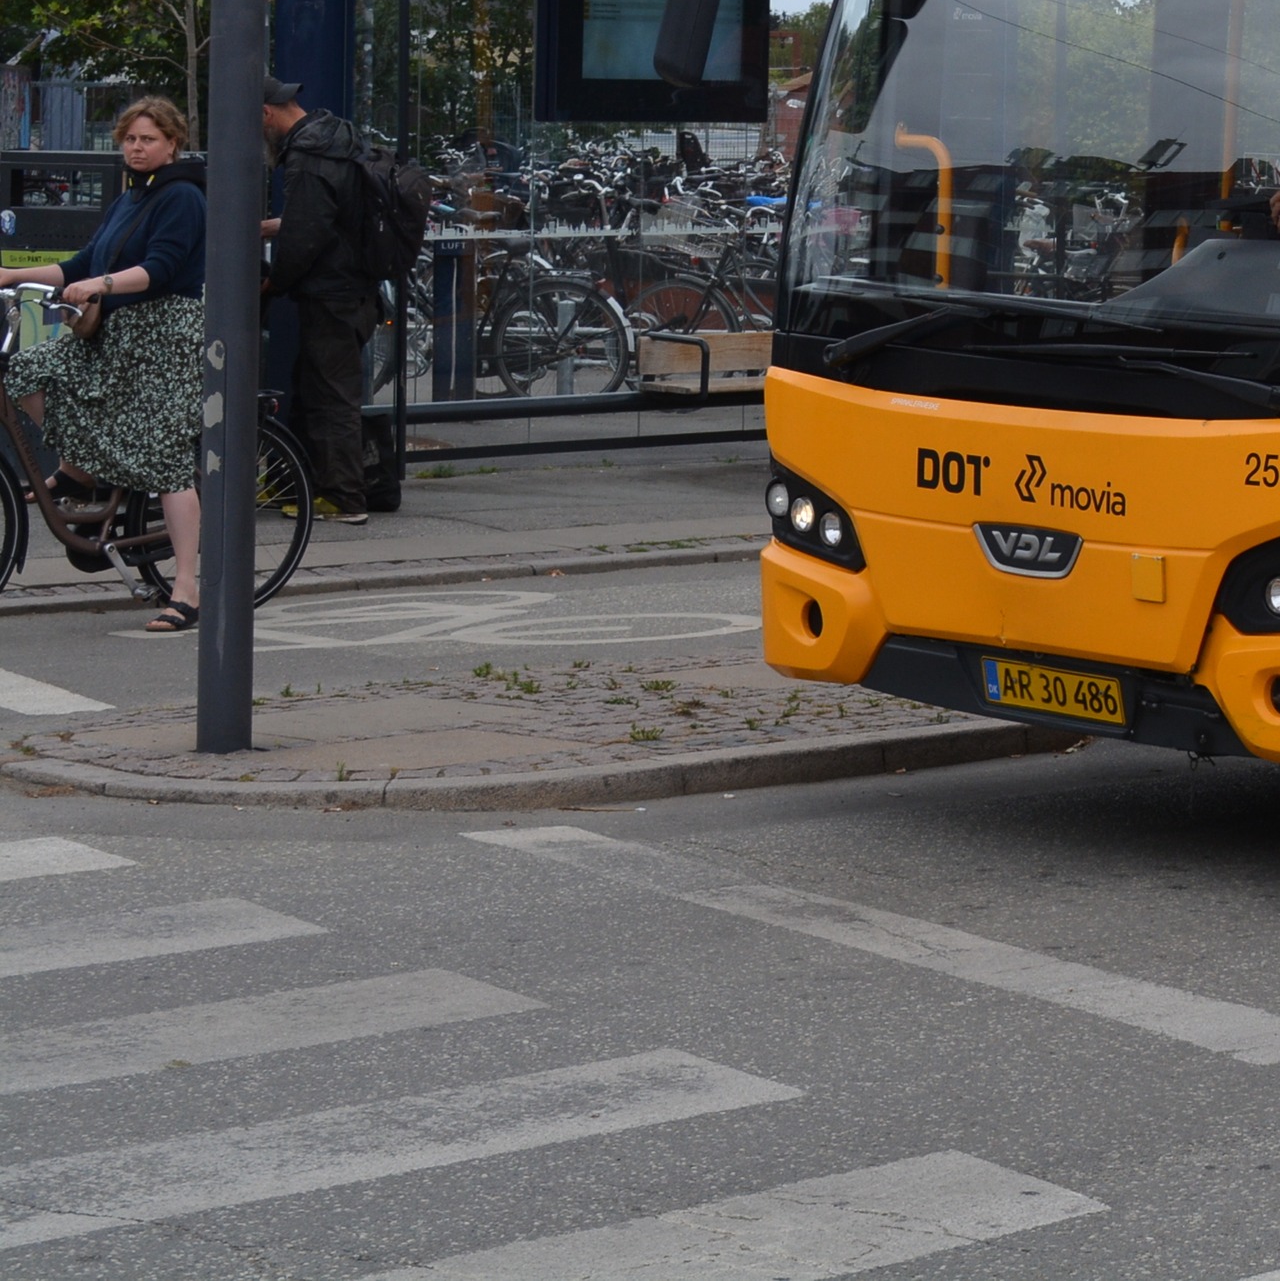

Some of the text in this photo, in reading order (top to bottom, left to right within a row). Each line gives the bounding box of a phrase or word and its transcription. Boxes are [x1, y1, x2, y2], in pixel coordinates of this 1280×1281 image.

[916, 447, 991, 496] DOT
[1050, 481, 1126, 516] movia
[991, 530, 1063, 562] VDL
[988, 683, 998, 694] DK
[1003, 667, 1118, 715] AR 30 486
